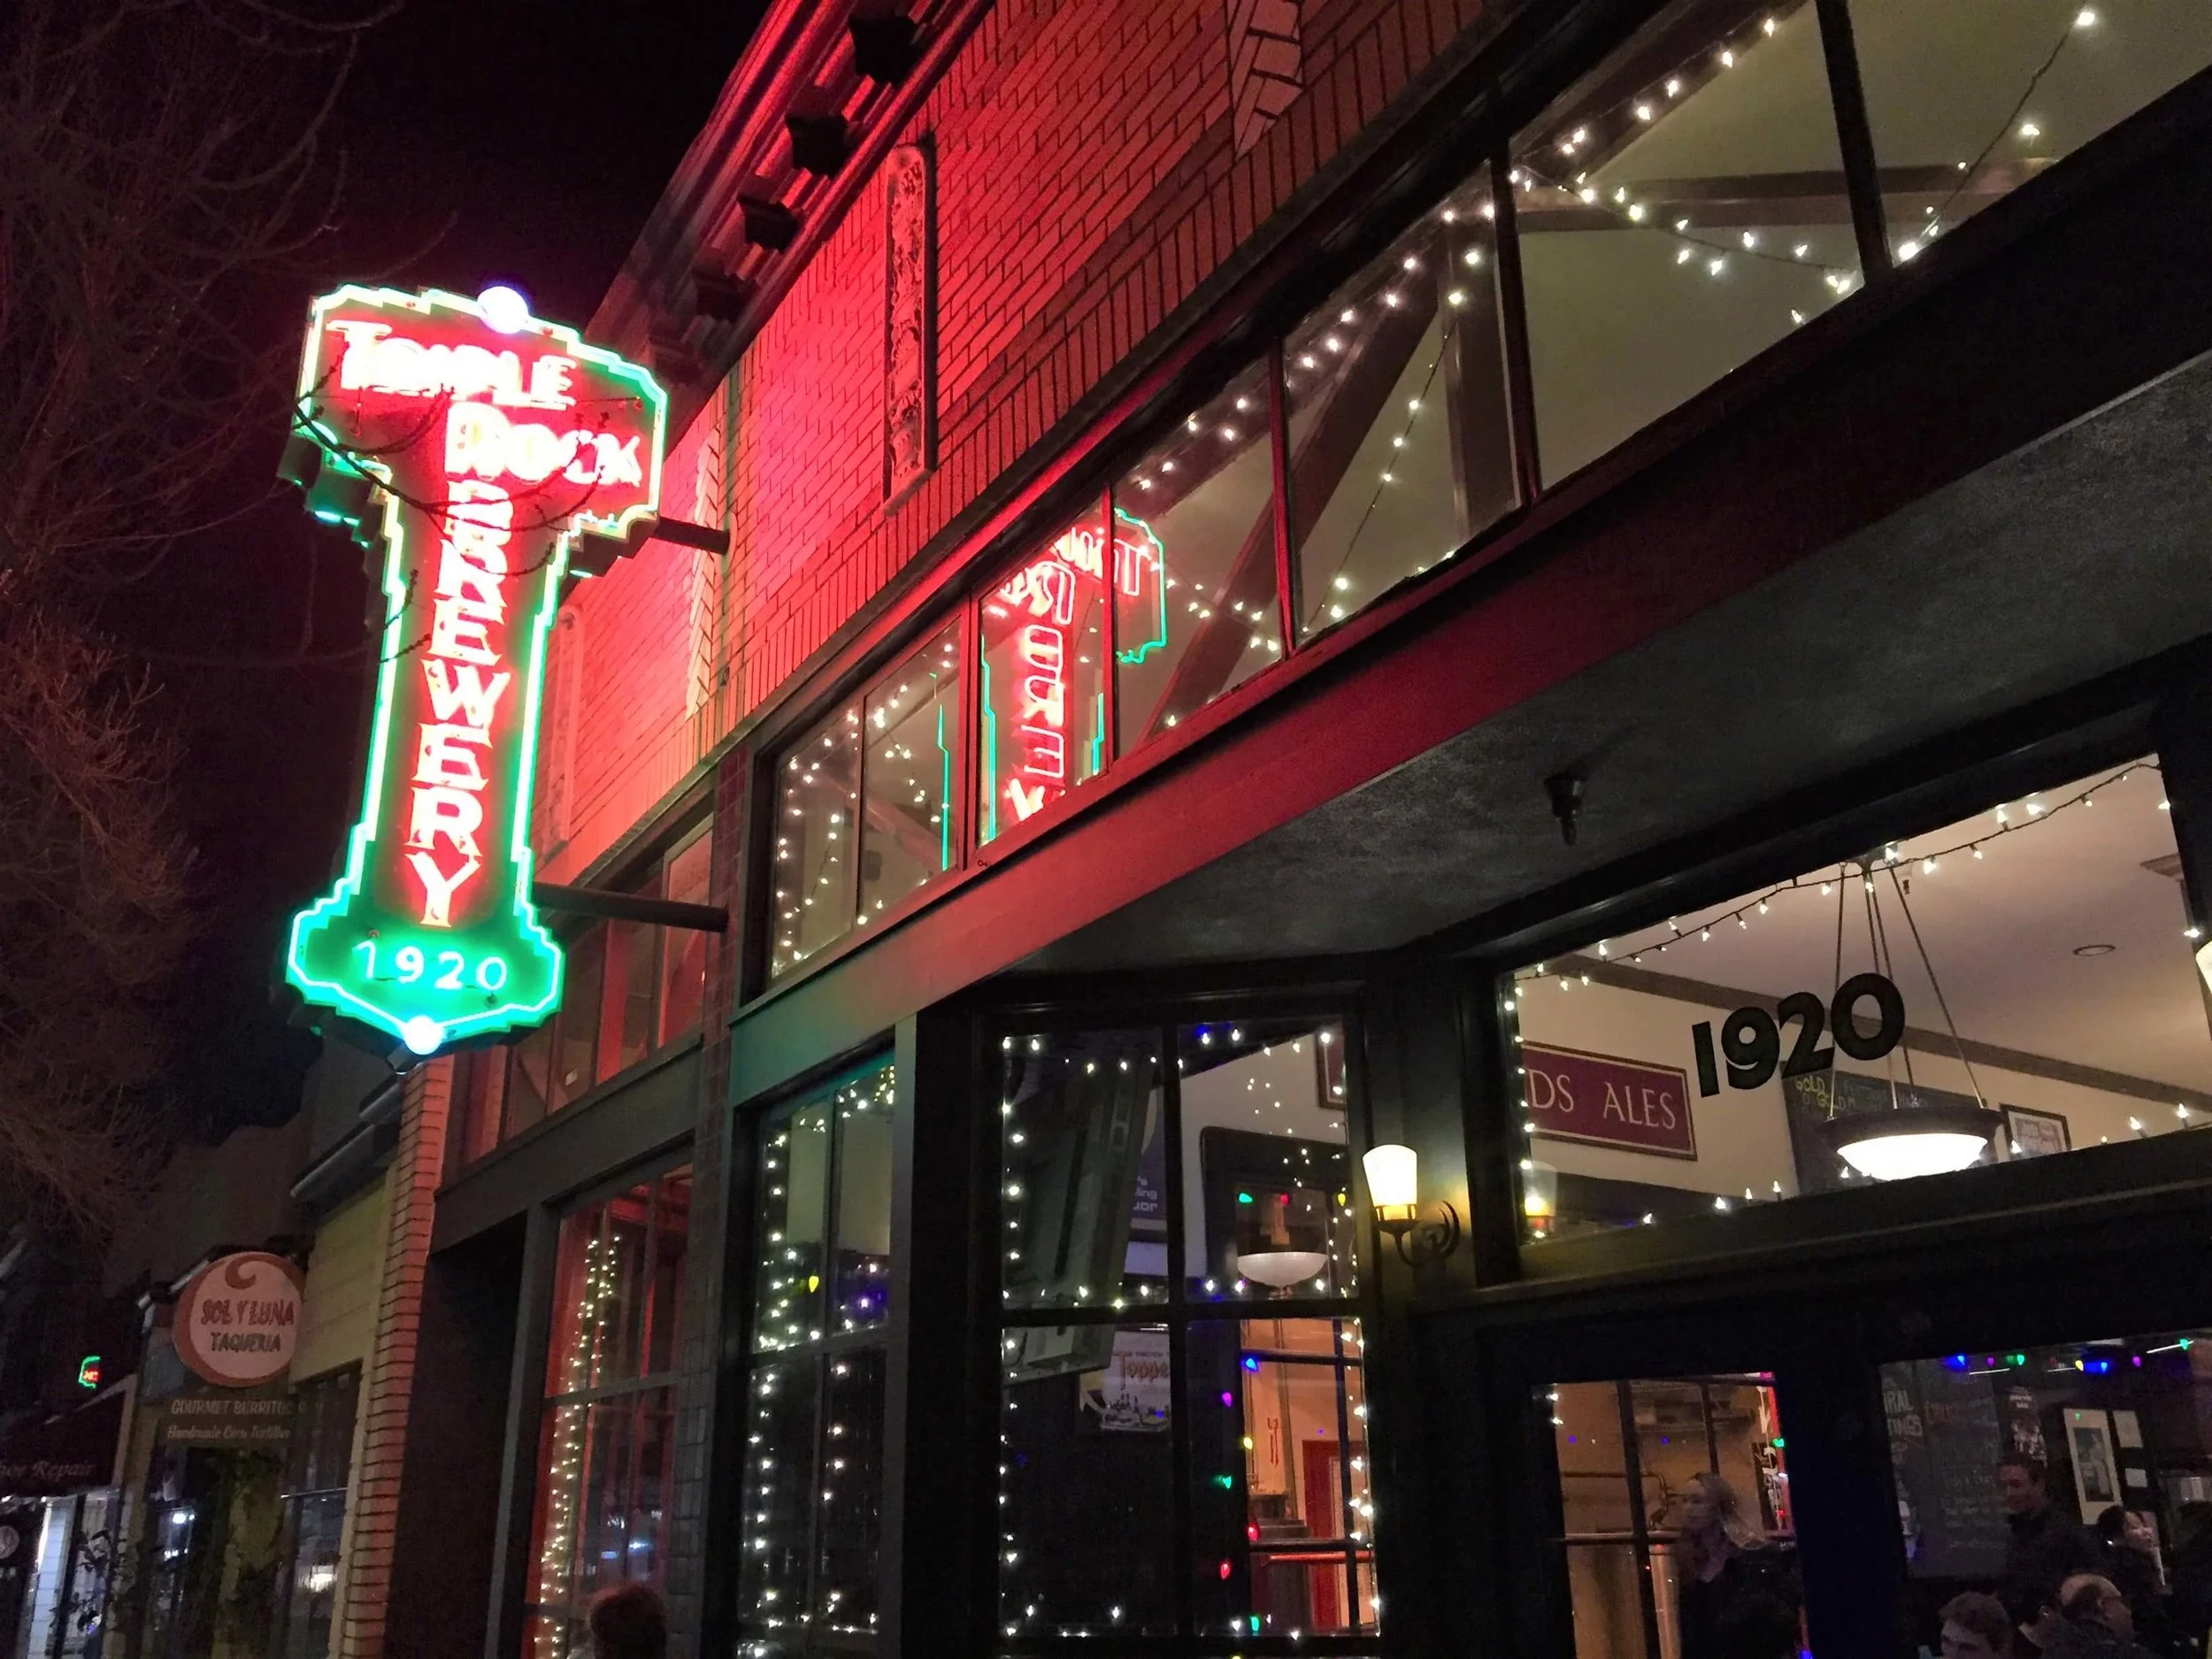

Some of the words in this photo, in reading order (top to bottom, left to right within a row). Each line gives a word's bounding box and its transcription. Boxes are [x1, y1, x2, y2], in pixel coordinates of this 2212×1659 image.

[444, 401, 642, 488] ROCK
[403, 479, 514, 927] BREWERY
[352, 939, 508, 992] 1920
[1691, 972, 1906, 1098] 1920
[1602, 1080, 1677, 1131] ALES
[201, 1299, 233, 1325] SOL
[237, 1300, 249, 1325] Y
[249, 1299, 295, 1325] LUNA
[210, 1333, 281, 1352] TAQUERIA
[172, 1399, 230, 1415] GOURMET
